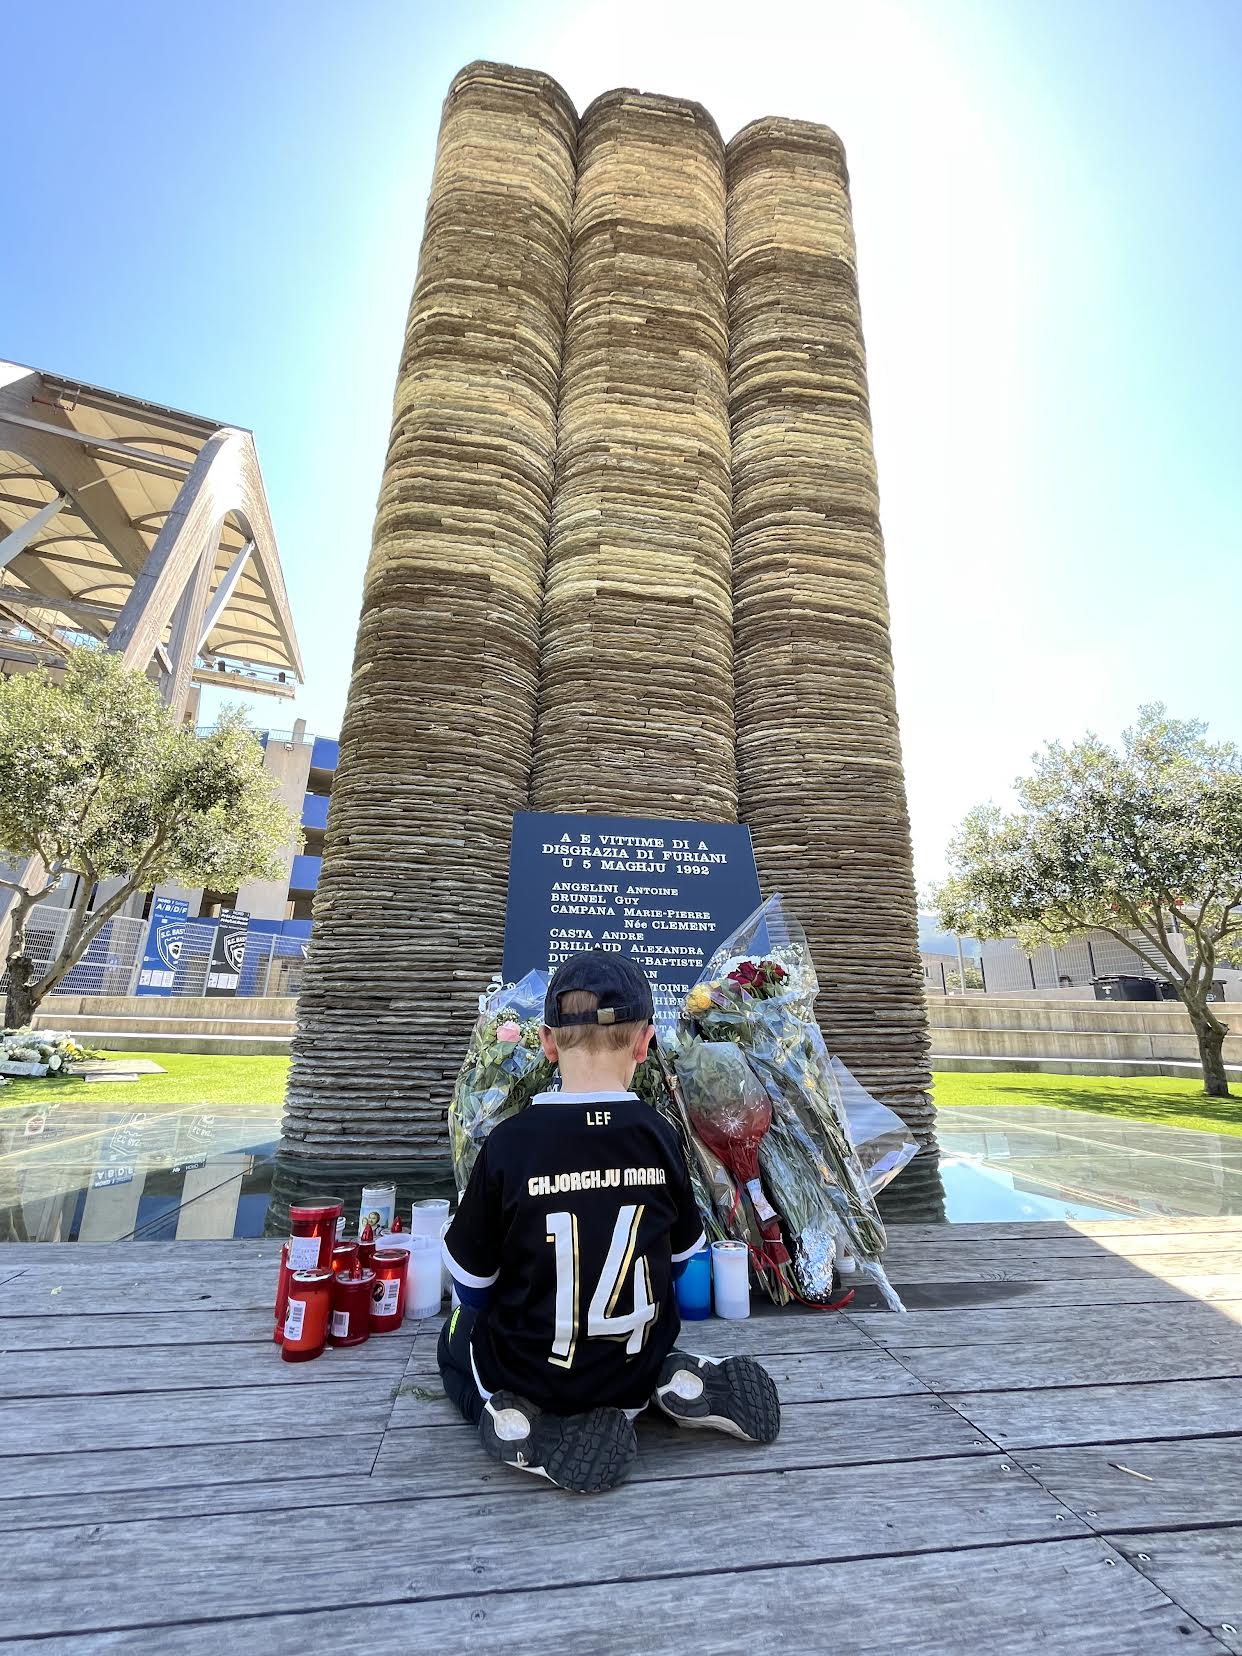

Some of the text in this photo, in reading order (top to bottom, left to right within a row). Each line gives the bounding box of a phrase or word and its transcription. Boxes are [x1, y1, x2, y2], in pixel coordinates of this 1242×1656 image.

[560, 833, 708, 850] A E VITTIME DI A
[541, 844, 728, 864] DISGRAZIA DI FURIANI
[562, 858, 710, 875] U 5 MAGHJU 1992
[552, 882, 679, 896] ANGELINI ANTOINE
[551, 893, 640, 905] BRUNEL GUY
[156, 904, 187, 914] A/B/D/F
[551, 905, 711, 920] CAMPANA MARIE-PIERRE
[624, 919, 716, 932] Née CLEMENT
[550, 928, 644, 941] CASTA ANDRE
[631, 944, 704, 955] ALEXANDRA
[586, 1111, 611, 1126] LEF
[528, 1168, 666, 1196] GHJORGHJU MARIA
[546, 1205, 660, 1369] 14
